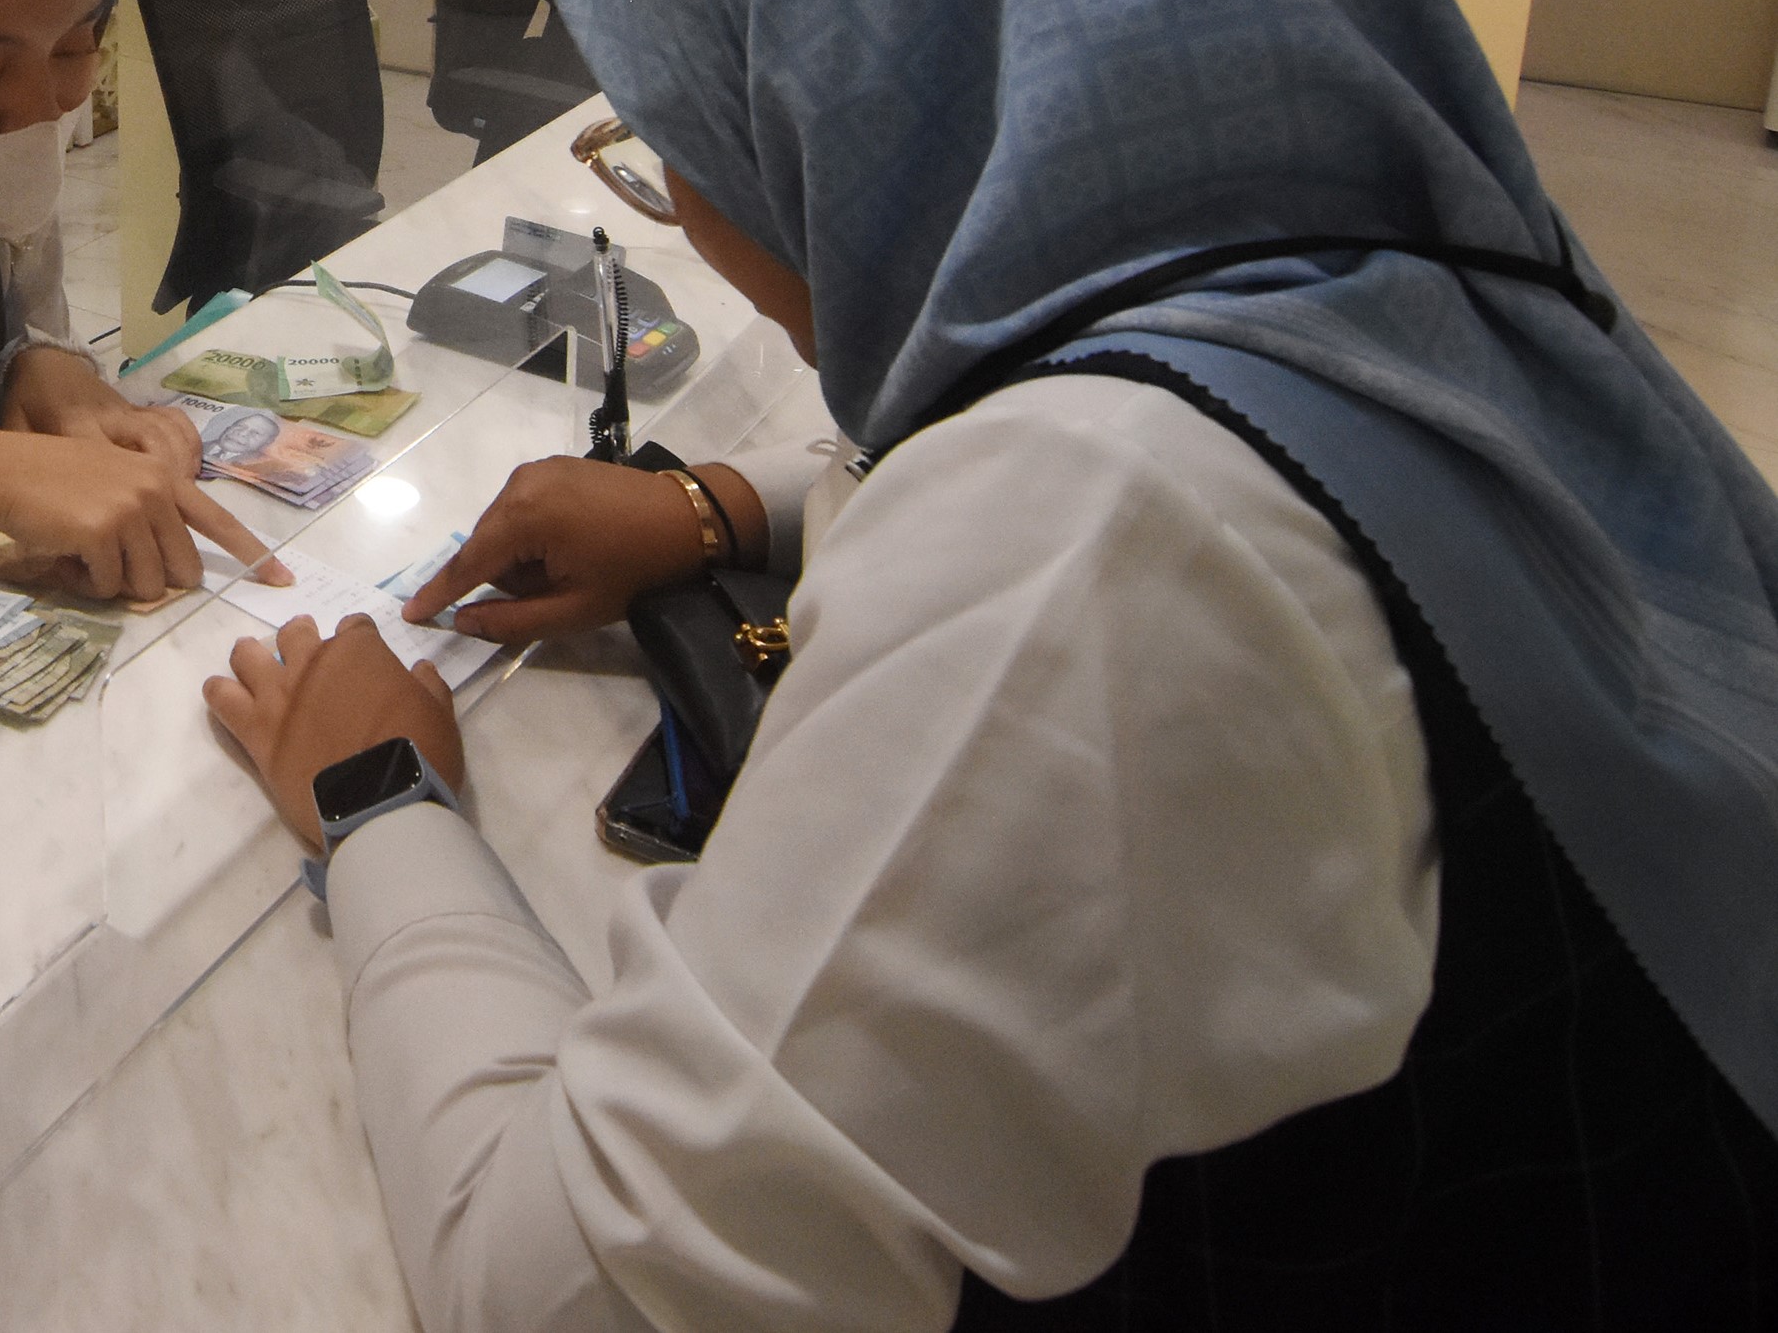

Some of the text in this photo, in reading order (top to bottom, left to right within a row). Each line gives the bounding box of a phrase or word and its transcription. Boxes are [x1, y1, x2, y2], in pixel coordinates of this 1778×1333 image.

[203, 351, 265, 371] 20000
[287, 356, 340, 367] 20000
[180, 396, 225, 414] 10000
